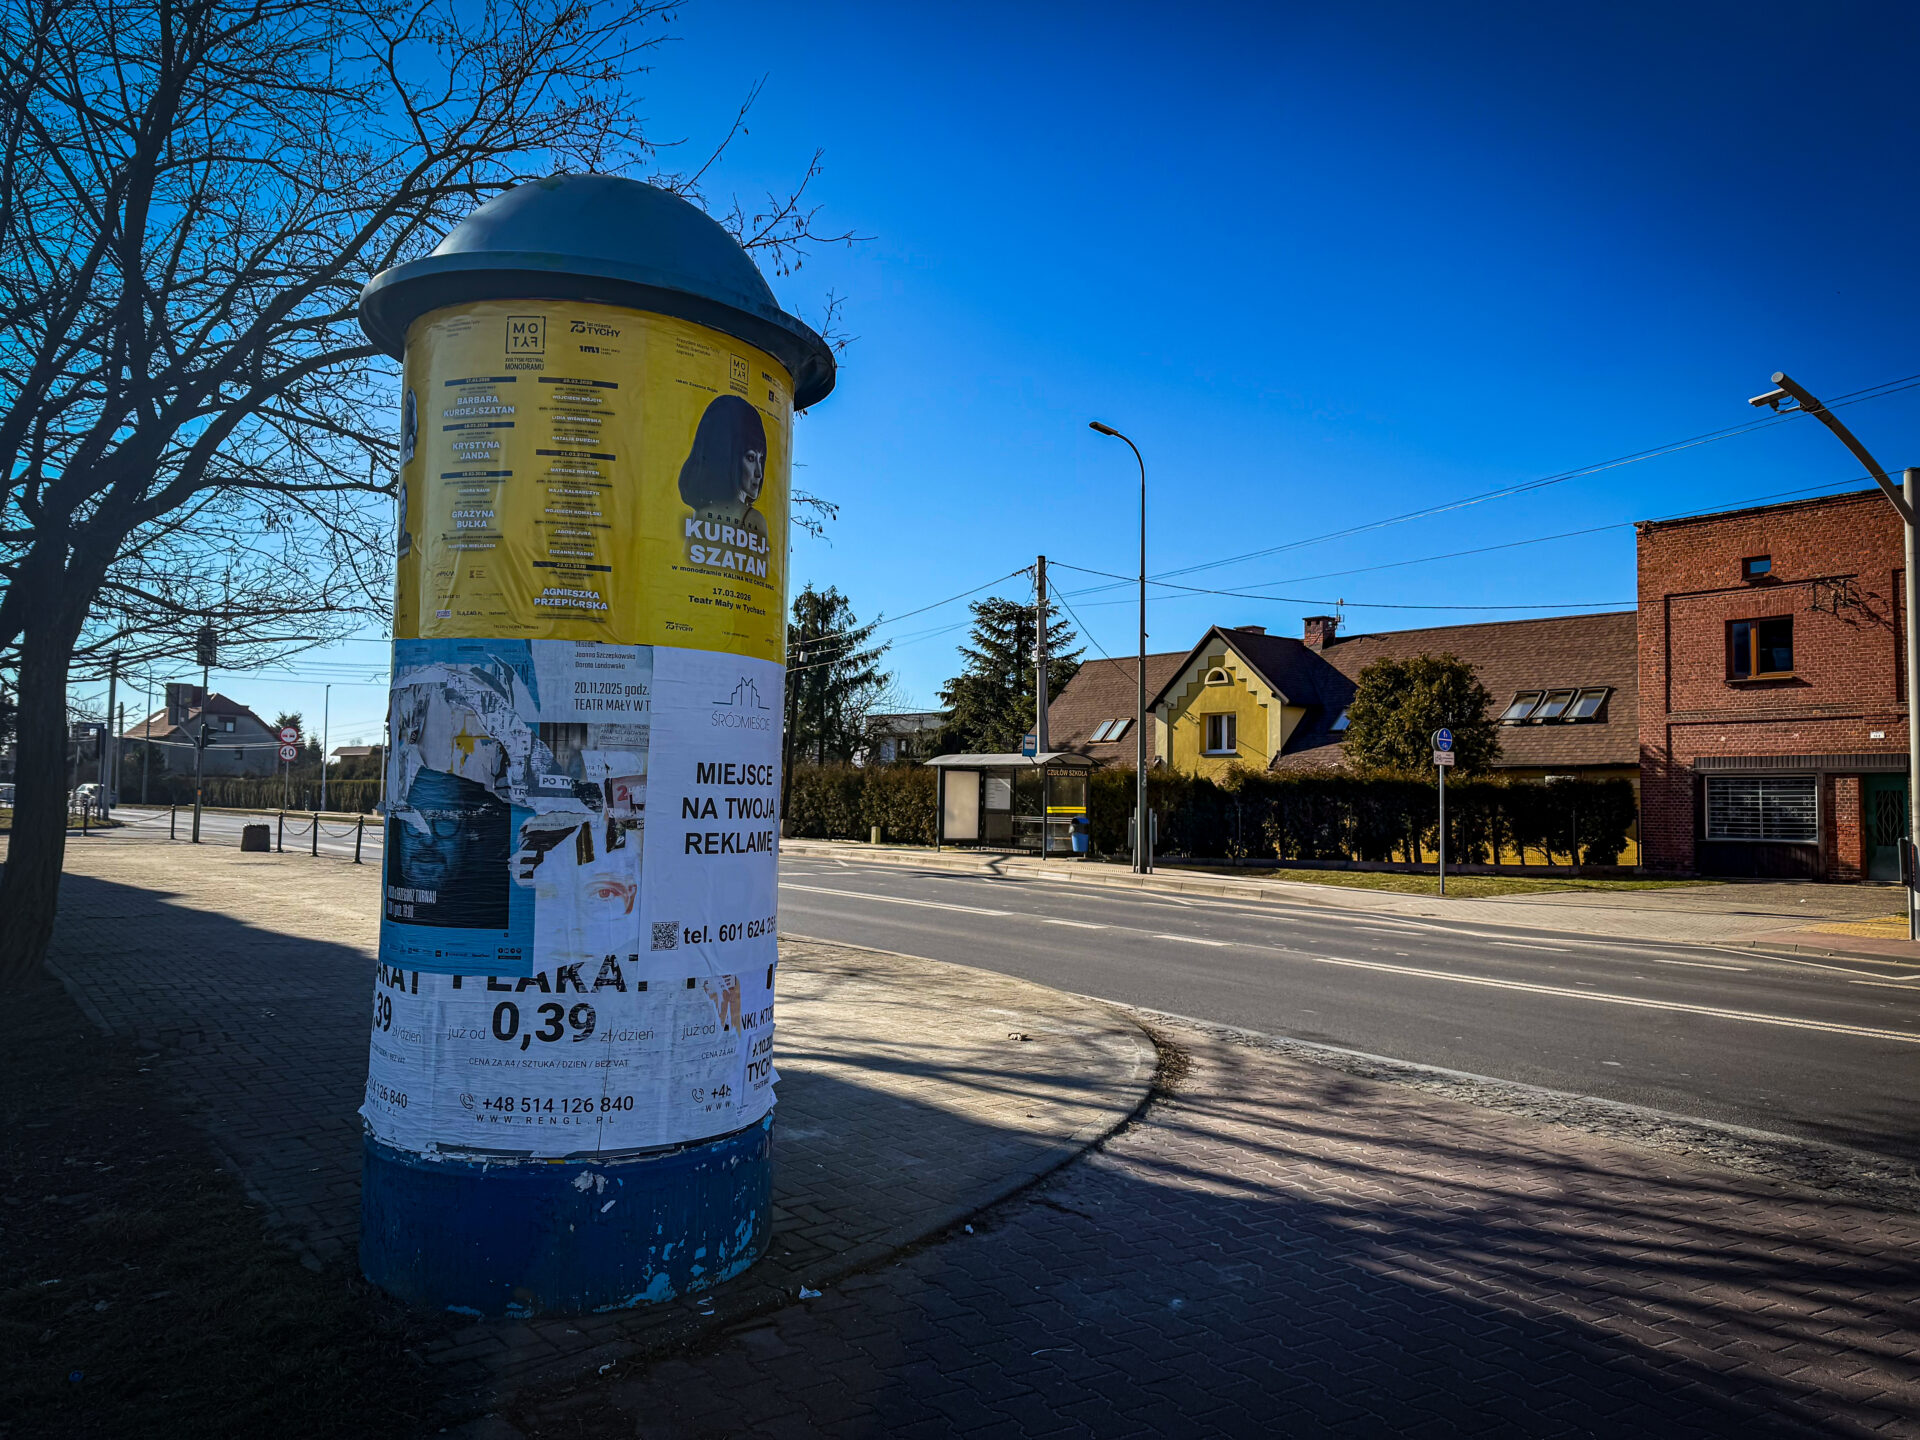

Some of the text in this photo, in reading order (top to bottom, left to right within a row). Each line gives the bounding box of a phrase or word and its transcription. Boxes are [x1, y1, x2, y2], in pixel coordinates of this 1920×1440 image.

[587, 327, 621, 338] TYCHY
[505, 363, 545, 371] MONODRAMU
[457, 396, 499, 405] BARBARA
[443, 406, 515, 417] KURDEJ-SZATAN
[452, 441, 500, 450] KRYSTYNA
[460, 452, 490, 460] JANDA
[686, 518, 770, 554] KURDEJ-
[690, 544, 767, 578] SZATAN
[543, 588, 600, 599] AGNIESZKA
[713, 588, 751, 601] 17.03.2026
[688, 595, 713, 605] Teatr
[715, 598, 734, 609] Mały
[596, 652, 636, 660] Szczepkowska
[575, 682, 650, 697] 20.11.2025 godz.
[574, 699, 603, 711] TEATR
[606, 699, 631, 711] MAŁY
[633, 700, 644, 712] W
[712, 711, 771, 731] ŚRÓDMIEŚCIE
[281, 748, 294, 757] 40
[697, 762, 773, 785] MIEJSCE
[616, 785, 628, 801] 2
[682, 797, 775, 823] NA TWOJĄ
[685, 831, 773, 856] REKLAMĘ
[684, 926, 712, 944] tel.
[719, 923, 742, 942] 601
[747, 919, 765, 938] 624
[447, 1001, 654, 1052] już od 0,39 zł/dzień
[682, 1021, 716, 1040] już od
[468, 1057, 490, 1066] CENA
[492, 1058, 502, 1067] ZA
[504, 1059, 516, 1067] A4
[522, 1060, 555, 1068] SZTUKA
[595, 1059, 611, 1068] BEZ
[613, 1059, 629, 1067] VAT
[390, 1089, 408, 1109] 840
[482, 1096, 634, 1113] +48 514 126 840
